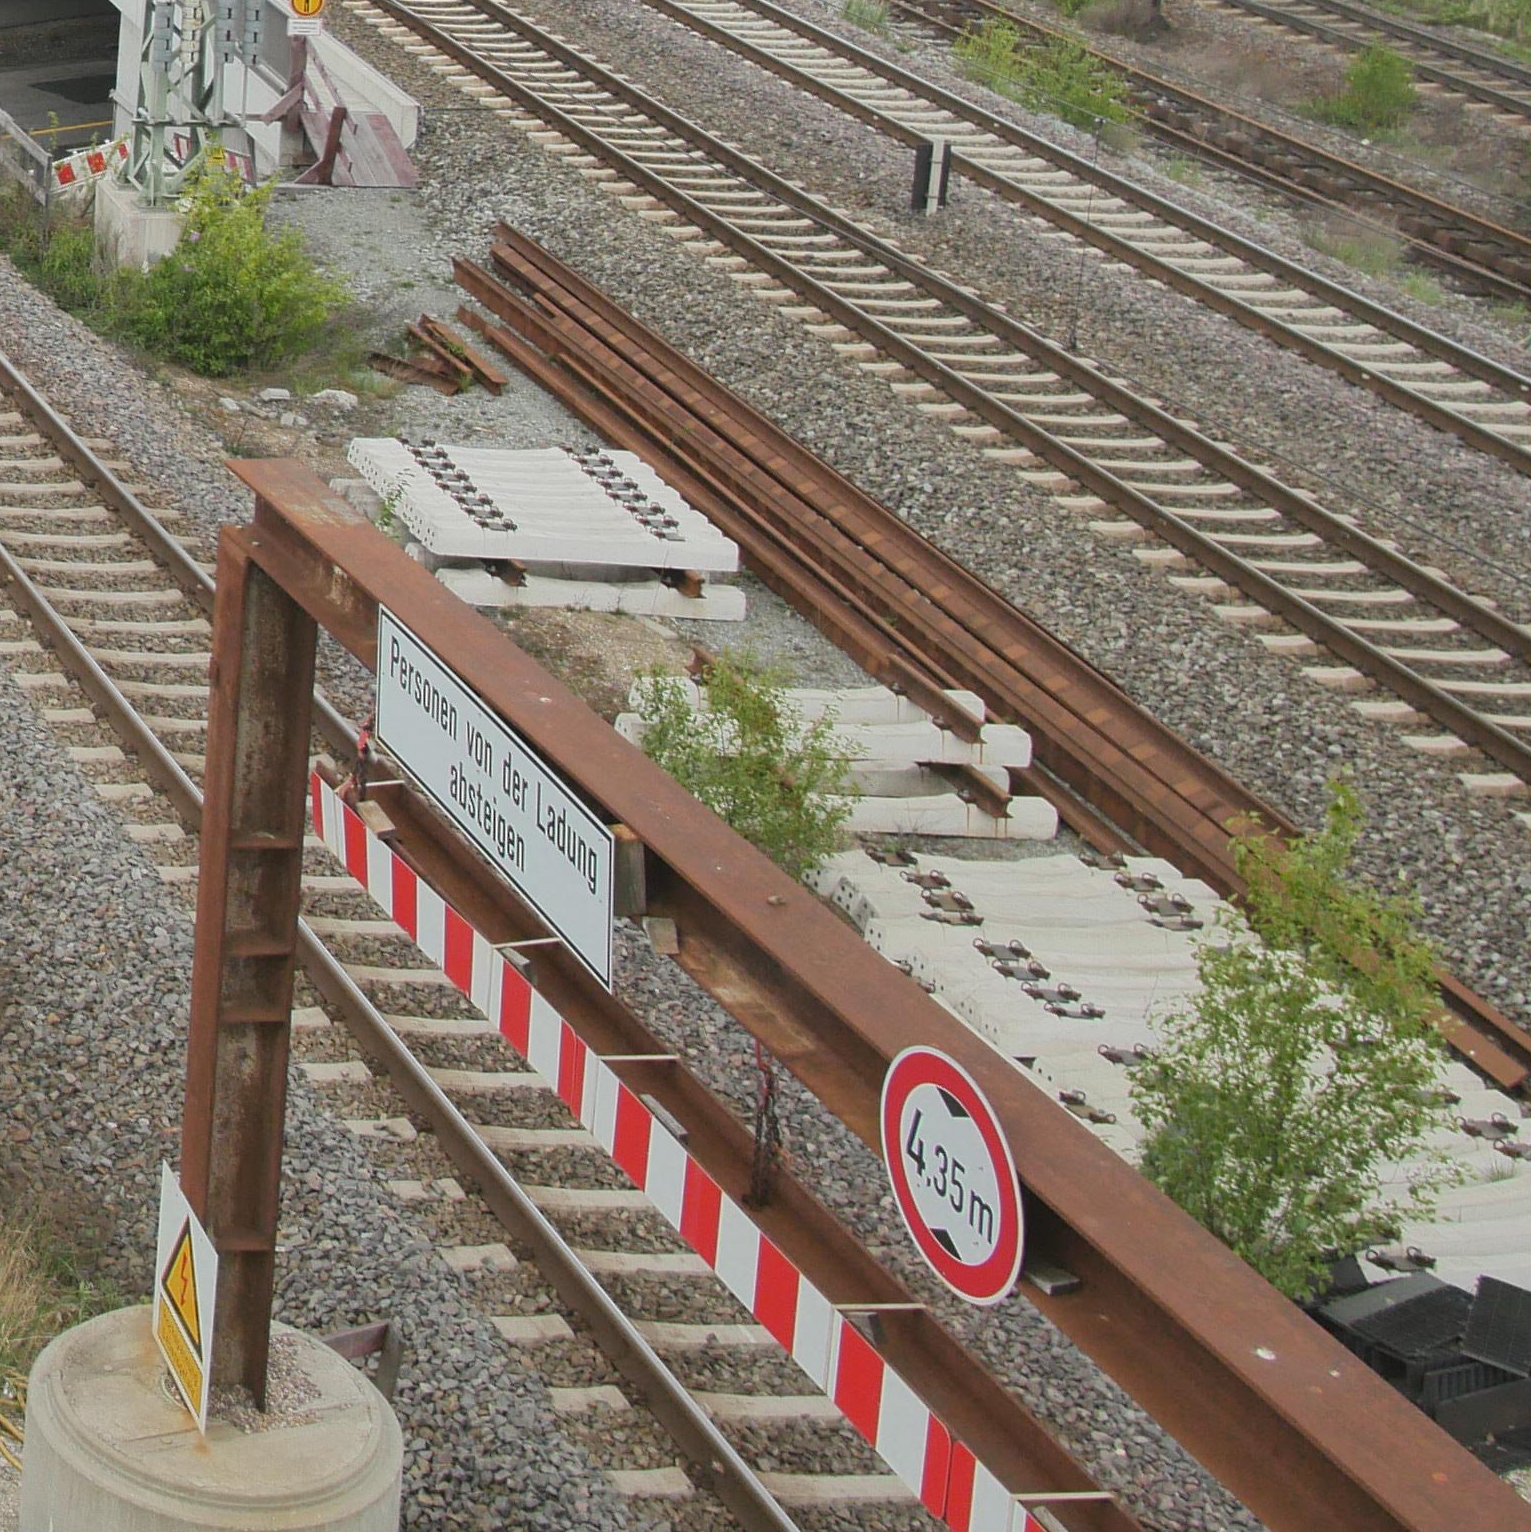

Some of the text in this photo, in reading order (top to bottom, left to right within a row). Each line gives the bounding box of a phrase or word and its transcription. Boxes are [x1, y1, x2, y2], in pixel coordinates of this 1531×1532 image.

[390, 635, 599, 895] Personen von der Ladung
[450, 763, 526, 872] absteigen
